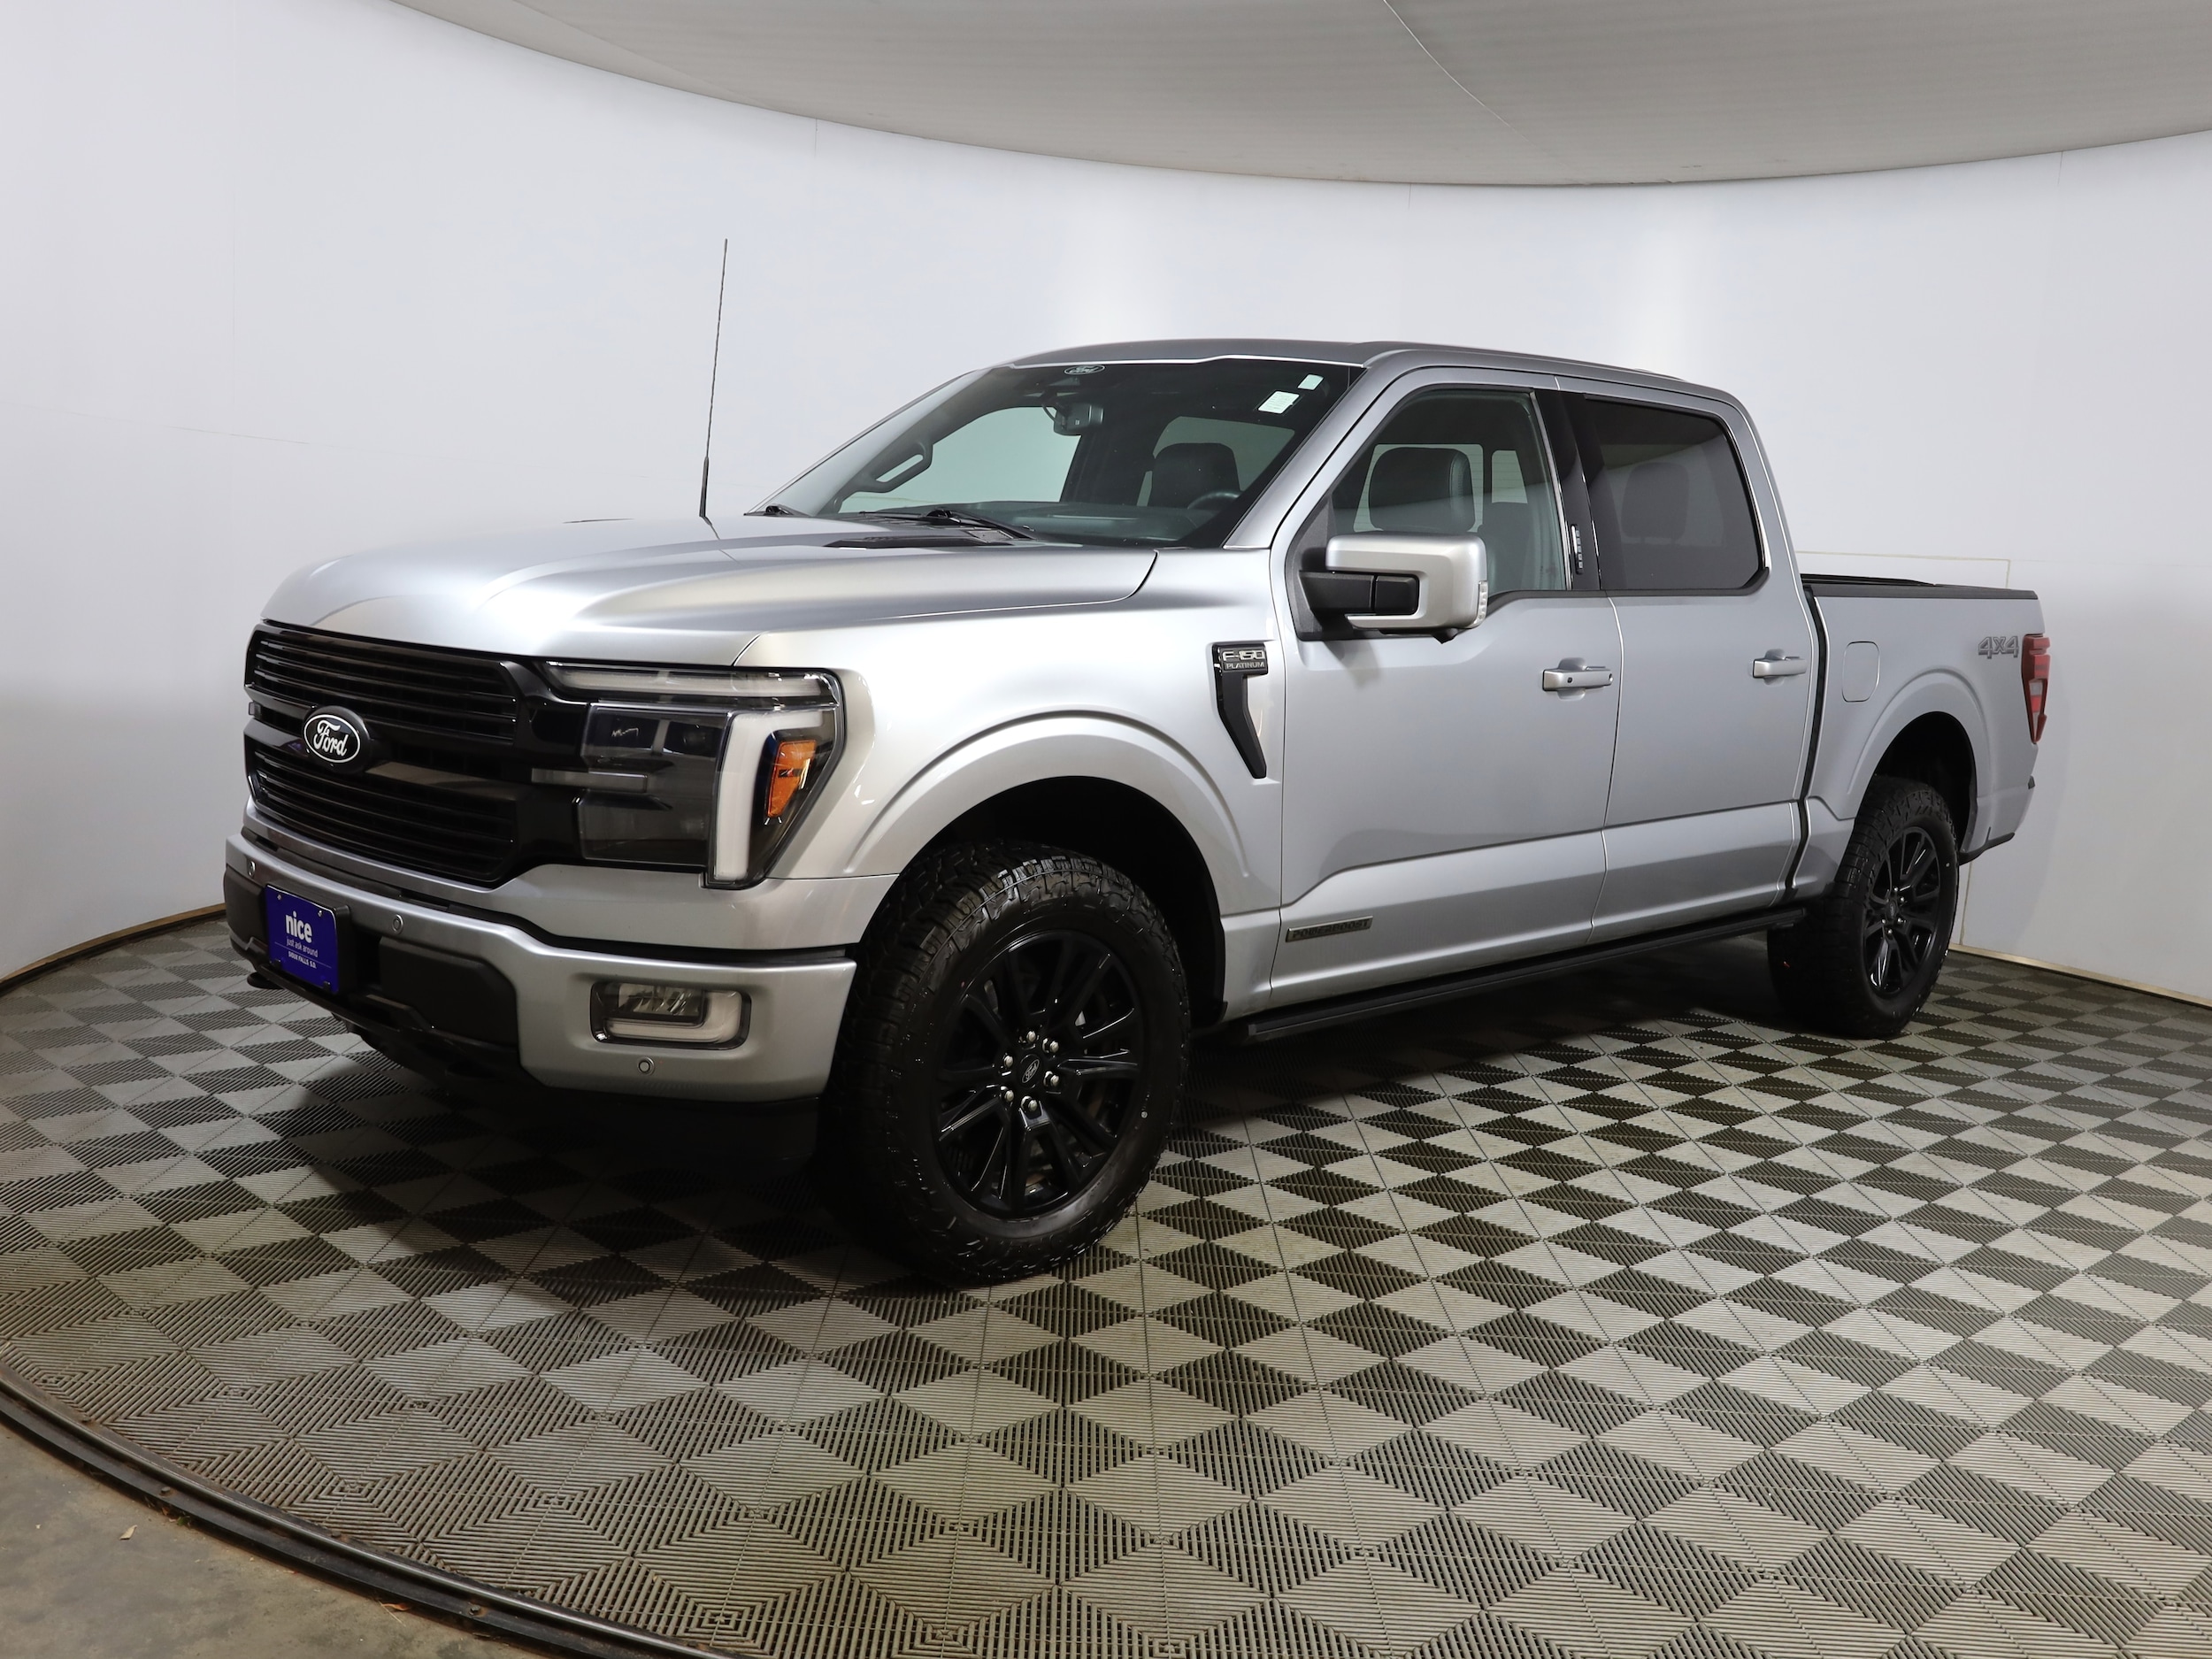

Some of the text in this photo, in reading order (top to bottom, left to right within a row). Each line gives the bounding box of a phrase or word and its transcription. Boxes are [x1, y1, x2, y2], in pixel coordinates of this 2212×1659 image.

[1222, 649, 1266, 661] F-150
[313, 719, 349, 757] Ford
[286, 910, 312, 944] nice
[1292, 918, 1371, 938] POWERBOOST
[286, 936, 295, 948] just
[303, 945, 319, 957] around
